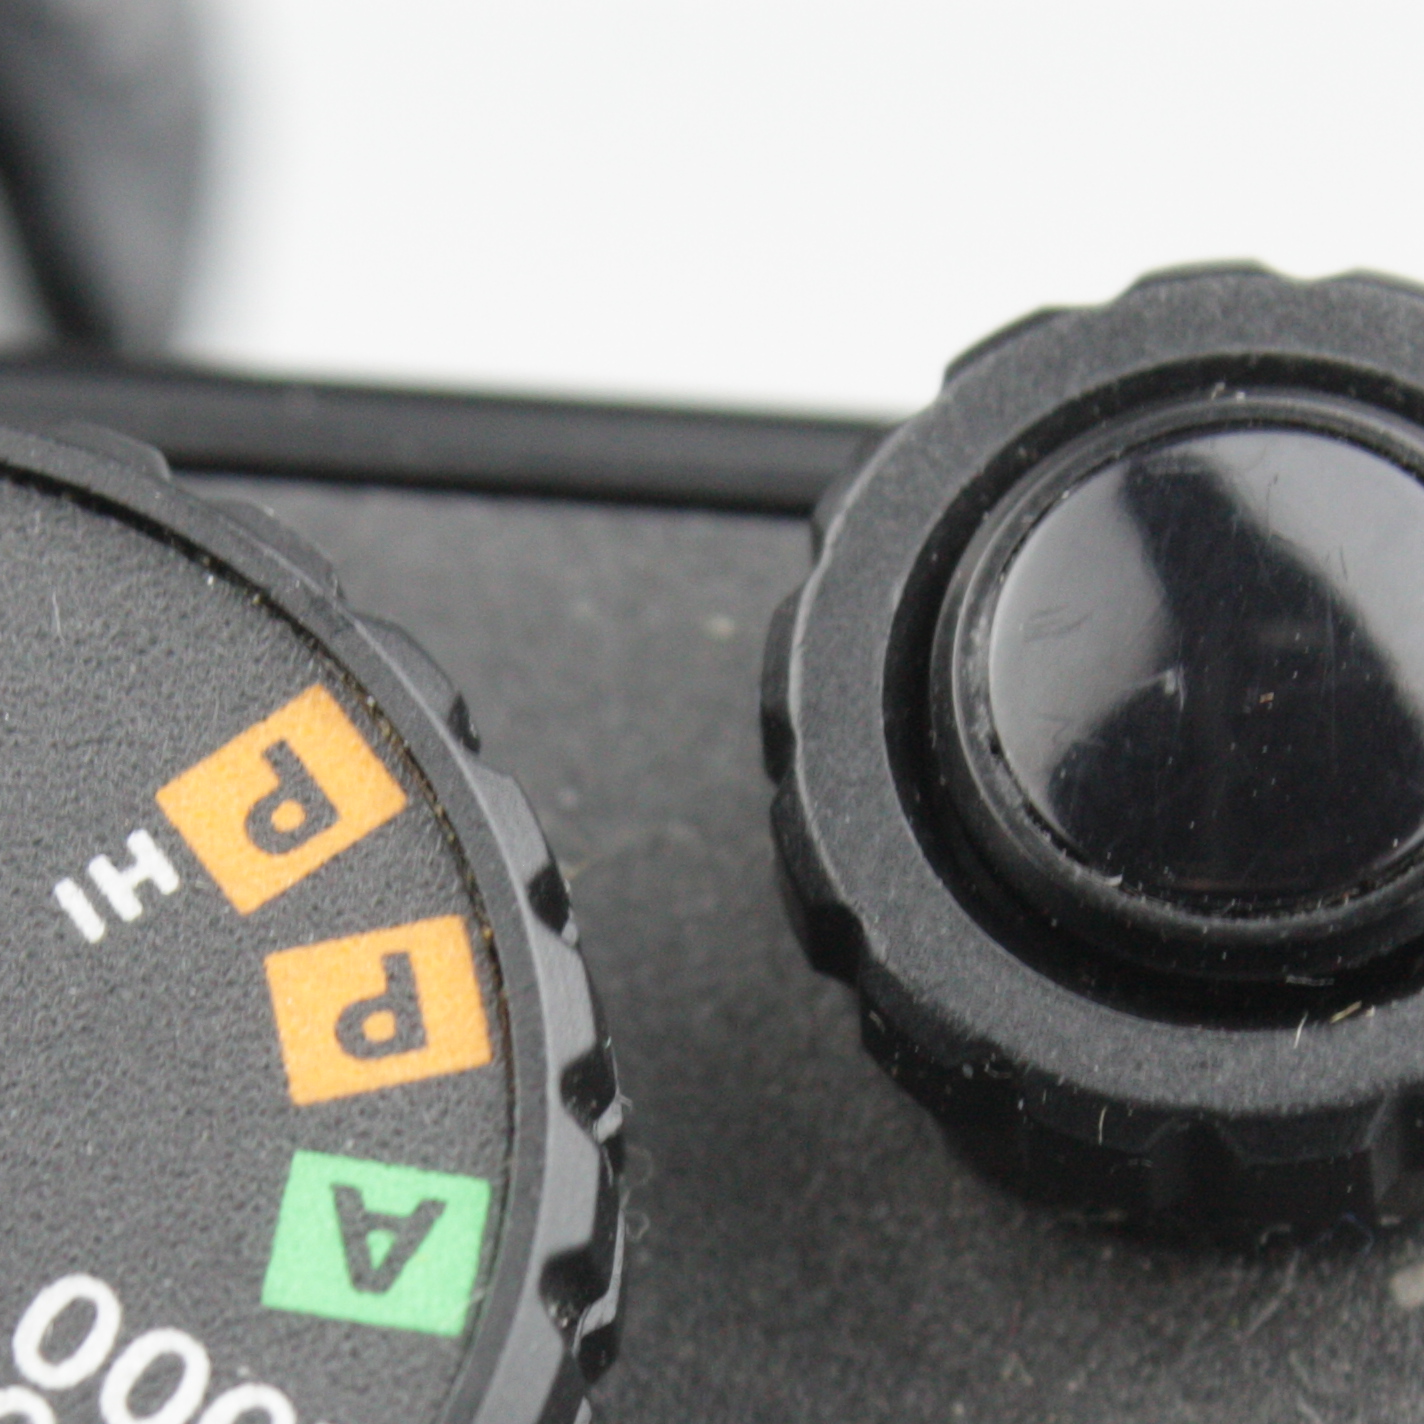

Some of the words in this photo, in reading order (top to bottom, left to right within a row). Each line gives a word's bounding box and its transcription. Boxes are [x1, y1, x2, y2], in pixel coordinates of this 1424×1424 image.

[244, 738, 339, 856] P
[53, 828, 180, 944] HI
[334, 951, 428, 1063] P
[329, 1181, 448, 1295] A
